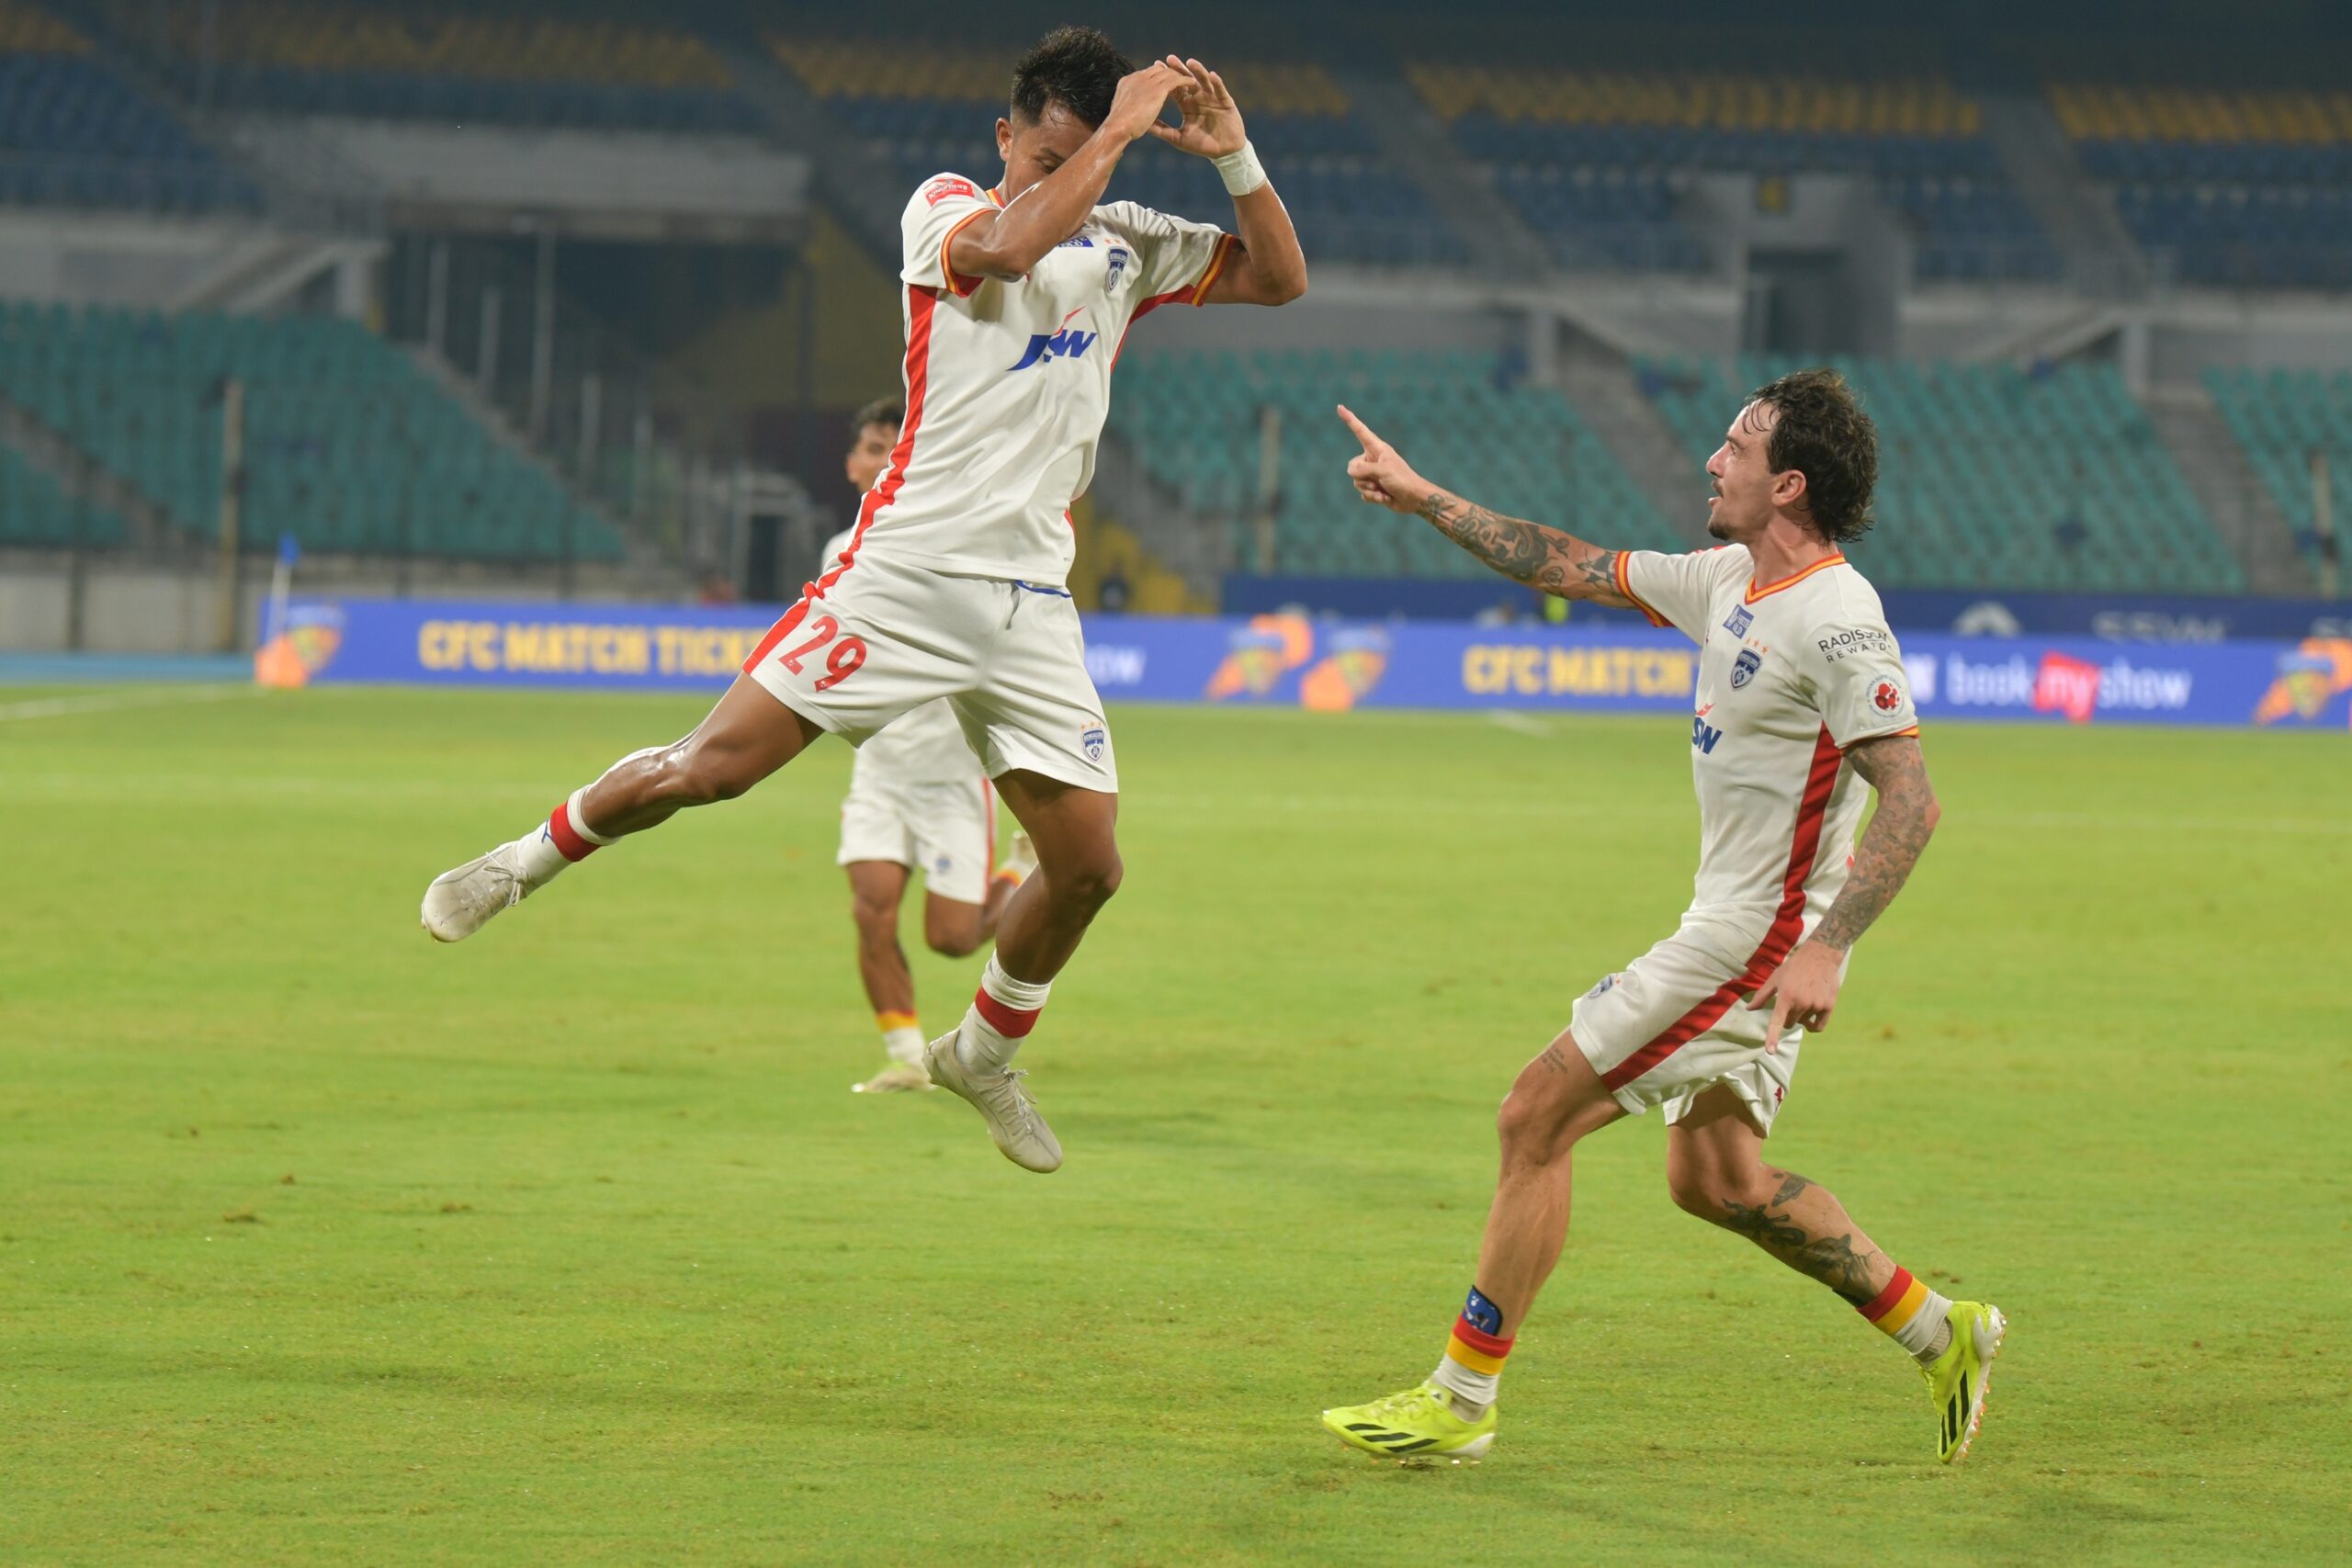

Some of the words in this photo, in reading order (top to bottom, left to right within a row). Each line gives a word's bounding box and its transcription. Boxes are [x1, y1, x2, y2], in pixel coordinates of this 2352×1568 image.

[419, 622, 496, 671] CFC
[503, 624, 649, 673] MATCH
[777, 615, 867, 694] 29
[1464, 646, 1544, 694] CFC
[1550, 648, 1692, 697] MATCH
[1826, 642, 1891, 662] REWAD
[1692, 716, 1723, 754] SW
